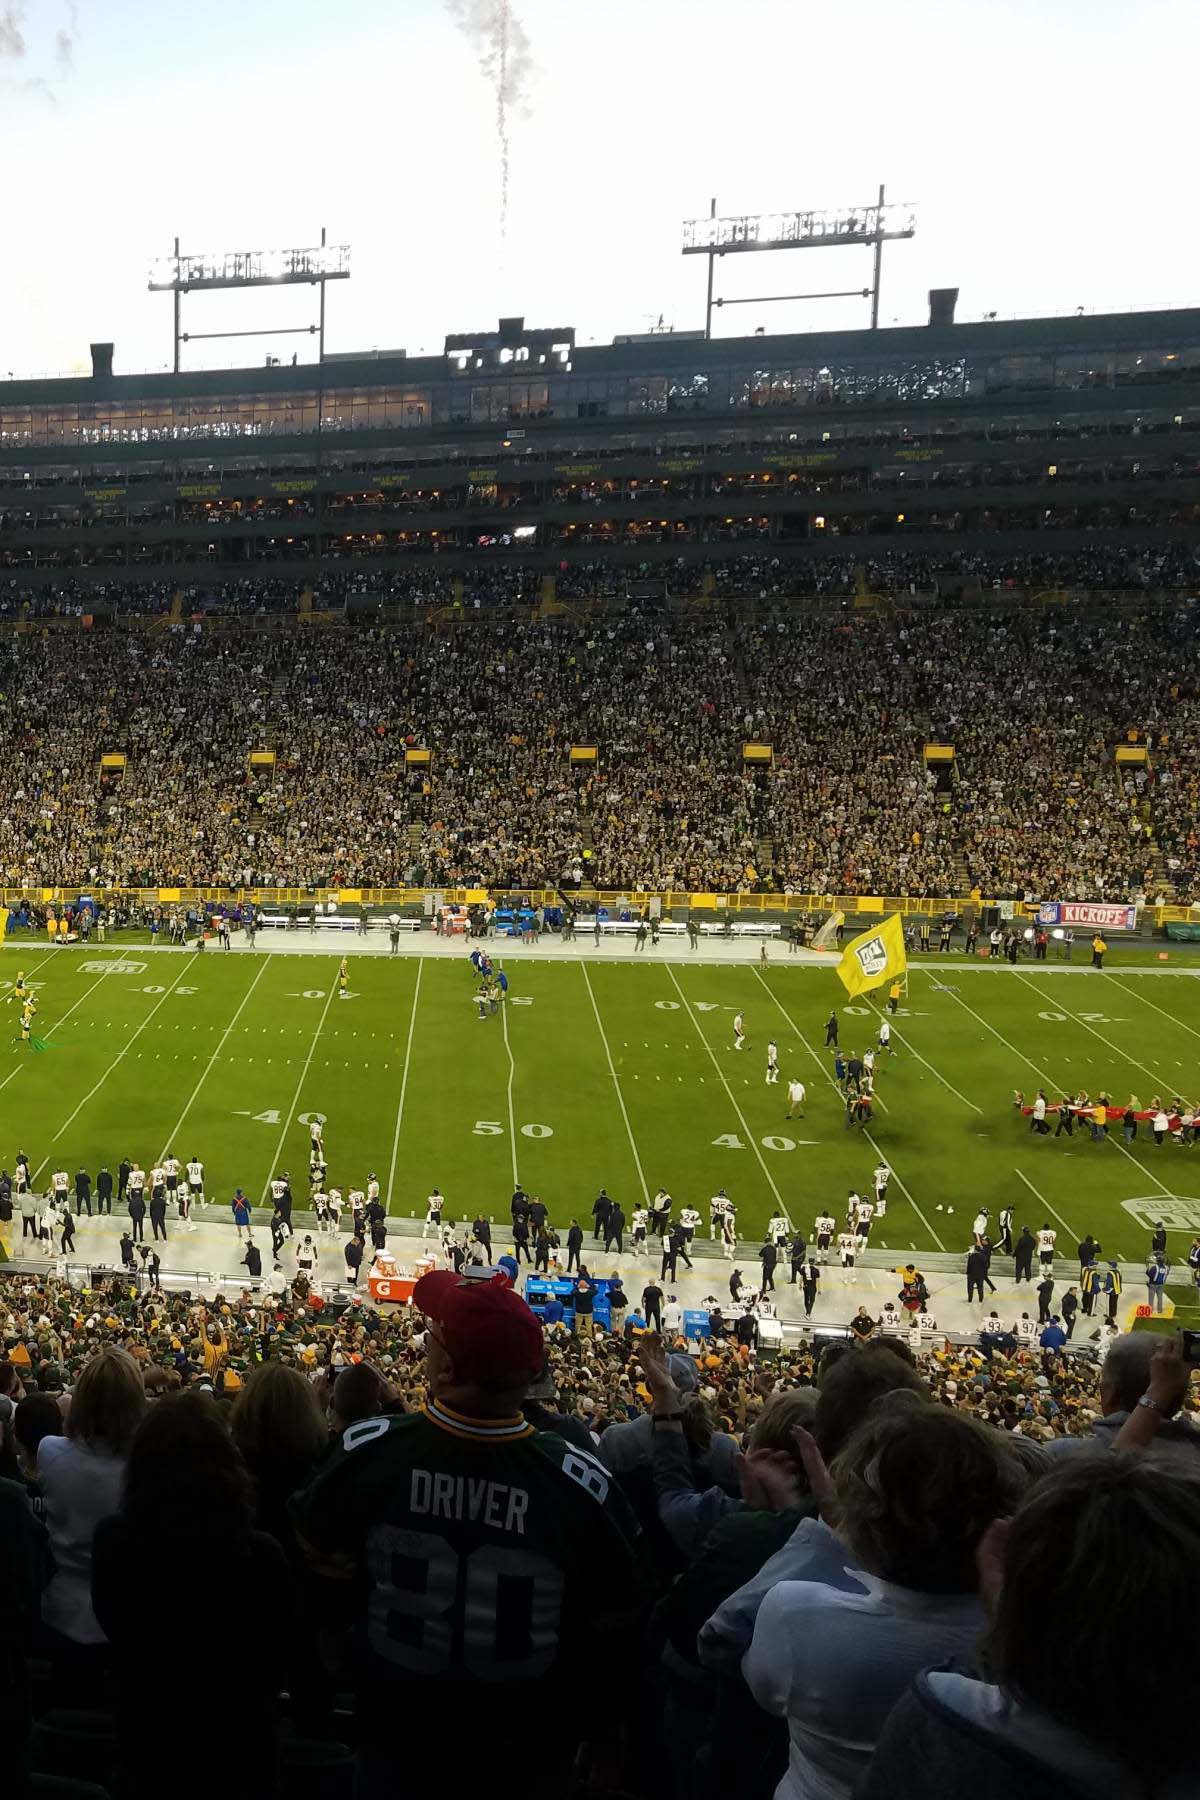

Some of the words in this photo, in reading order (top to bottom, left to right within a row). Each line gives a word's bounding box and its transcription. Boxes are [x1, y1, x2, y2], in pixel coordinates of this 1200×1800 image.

[1065, 906, 1124, 925] KICKOFF
[252, 1110, 327, 1125] 40
[472, 1121, 553, 1138] 50
[711, 1134, 797, 1151] 40
[376, 1281, 391, 1296] G
[409, 1468, 529, 1535] DRIVER
[366, 1522, 565, 1683] 80
